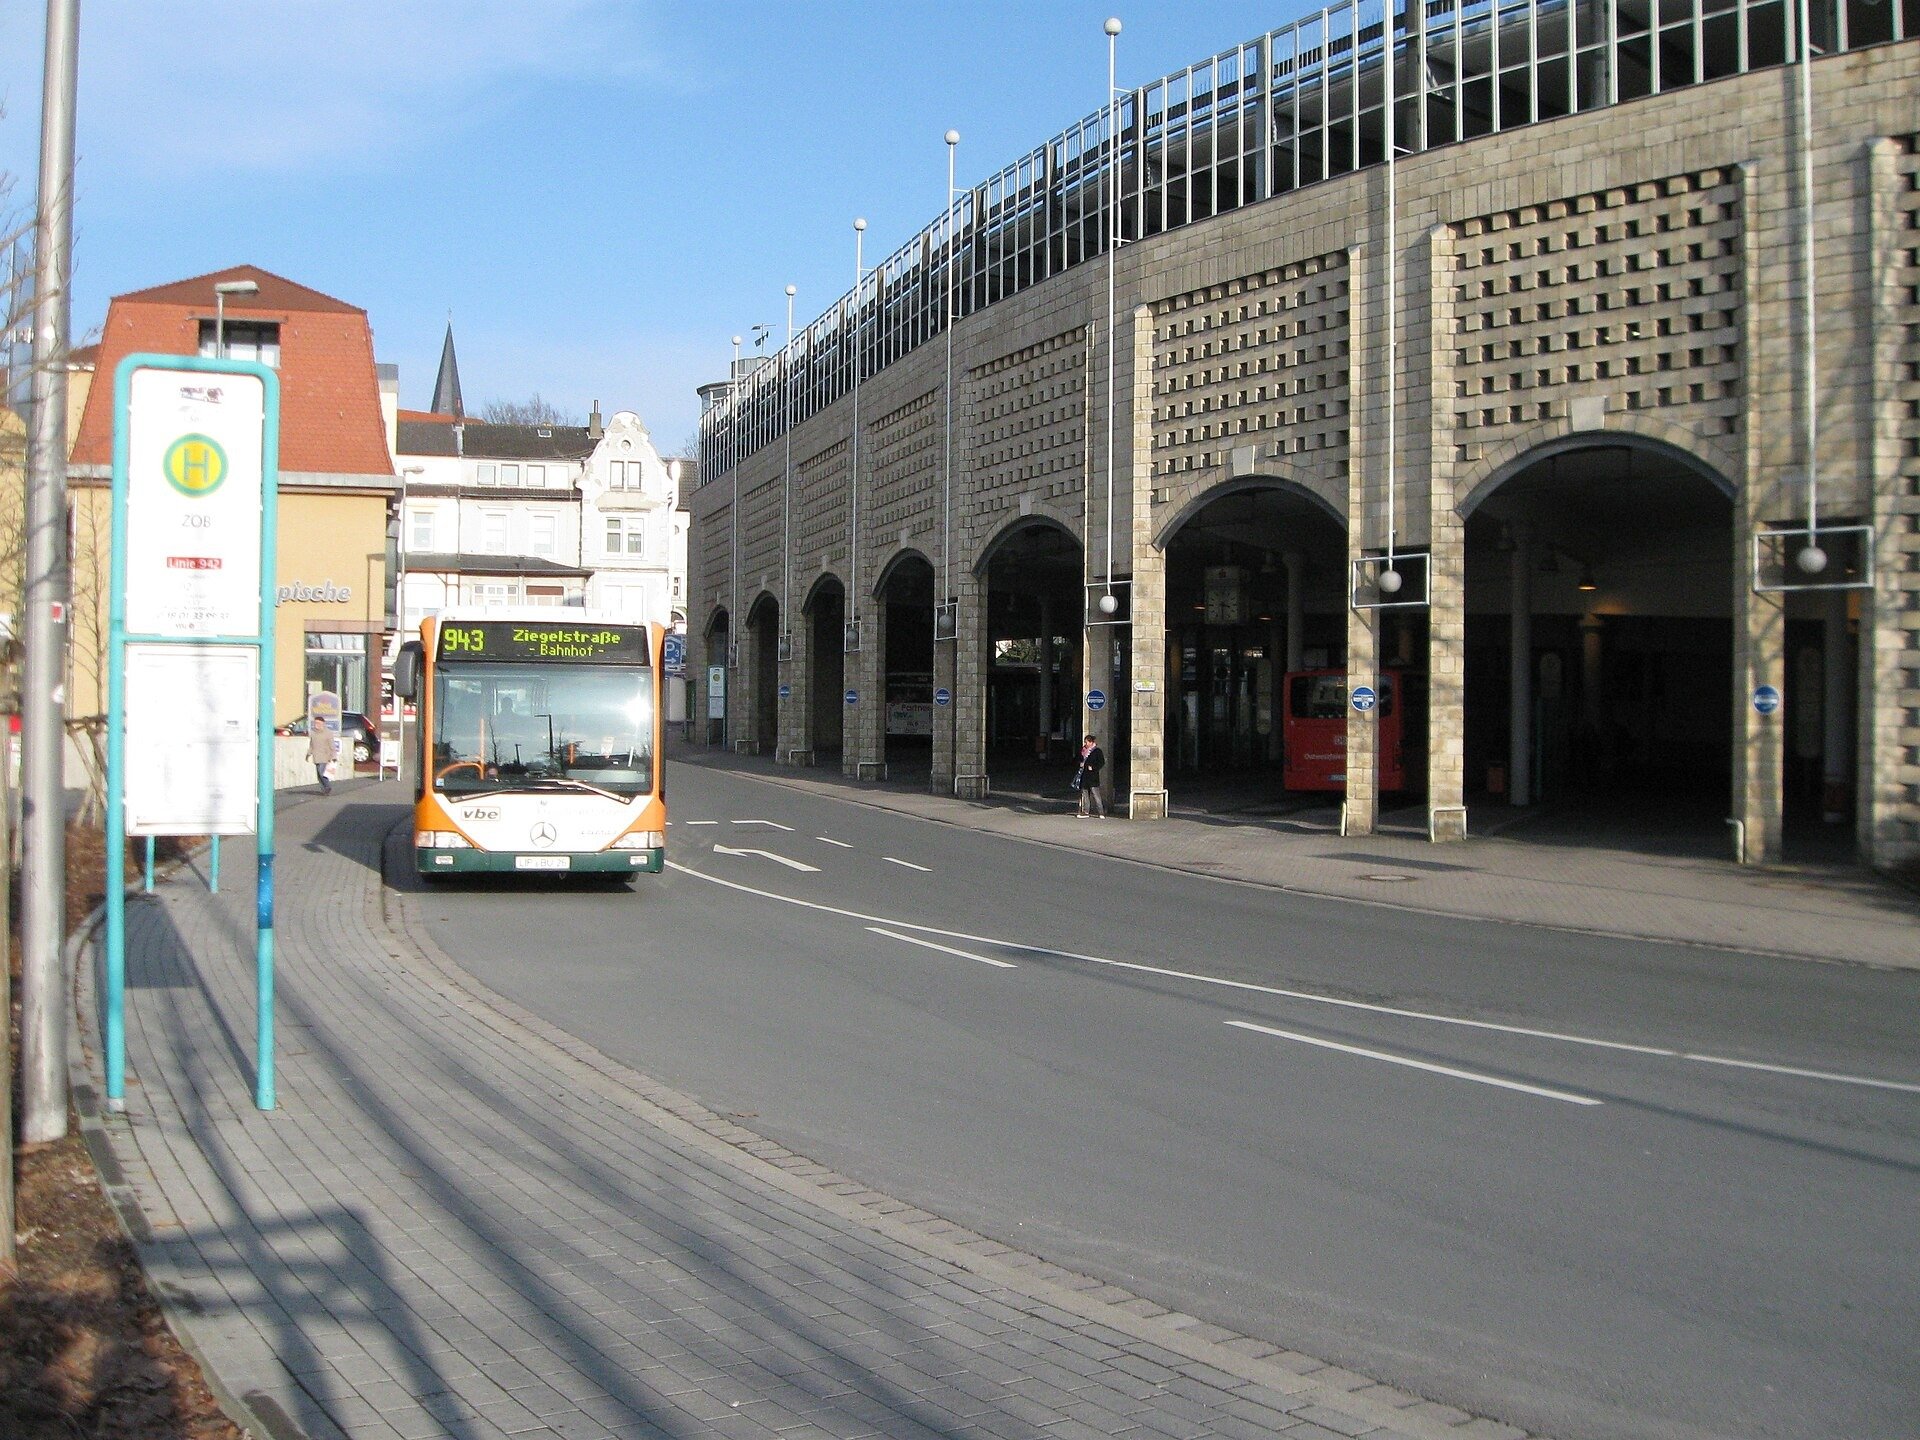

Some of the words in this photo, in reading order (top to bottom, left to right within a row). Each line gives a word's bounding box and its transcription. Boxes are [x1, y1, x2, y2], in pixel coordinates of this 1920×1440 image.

[183, 448, 210, 482] H
[181, 514, 211, 528] ZOB
[168, 557, 197, 569] Linie
[275, 578, 351, 607] pische
[444, 628, 484, 651] 943
[513, 629, 621, 645] Ziegelstraße
[540, 644, 594, 657] Bahnhof
[463, 806, 499, 820] vbe
